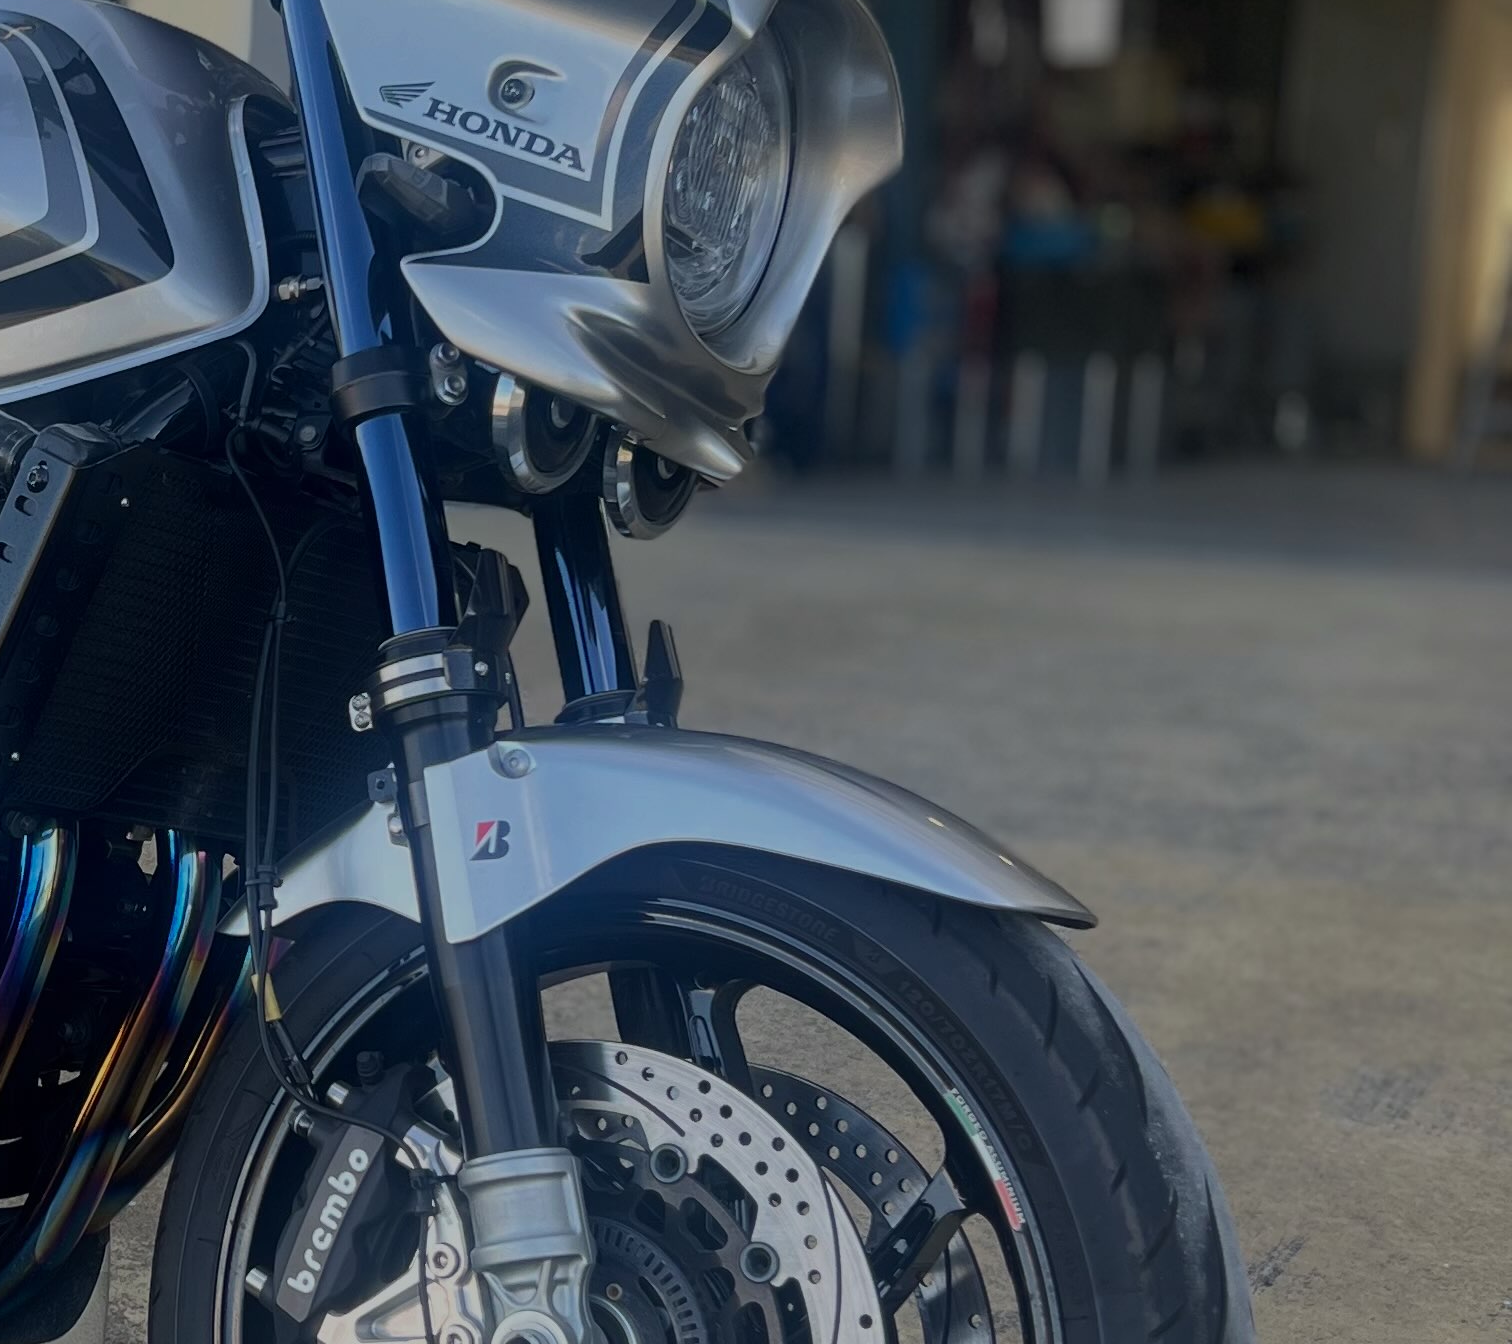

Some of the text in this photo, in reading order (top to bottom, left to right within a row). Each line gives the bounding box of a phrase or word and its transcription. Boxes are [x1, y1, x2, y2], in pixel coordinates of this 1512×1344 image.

[422, 97, 585, 172] HONDA
[951, 1087, 988, 1141] FORGED
[287, 1148, 370, 1295] brembo
